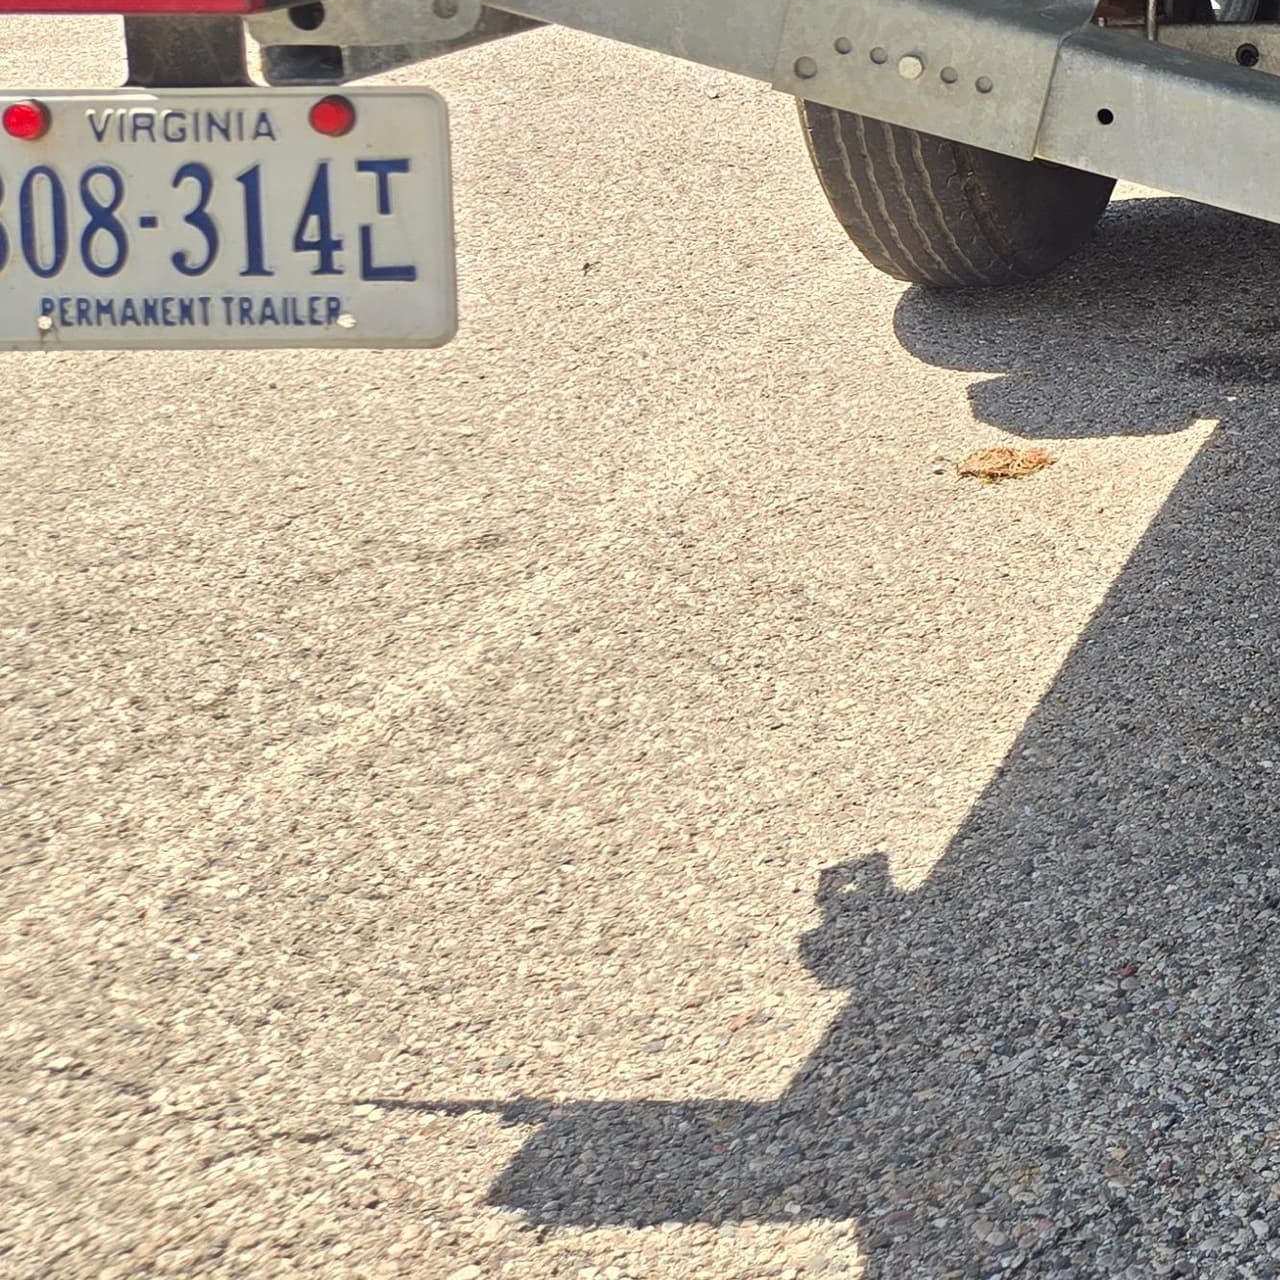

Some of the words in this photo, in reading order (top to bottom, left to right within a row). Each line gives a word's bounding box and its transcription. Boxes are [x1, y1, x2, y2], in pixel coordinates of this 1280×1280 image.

[86, 109, 277, 143] VIRGINIA
[0, 160, 346, 279] 08-314
[41, 296, 209, 328] PERMANENT
[222, 296, 346, 326] TRAILER
